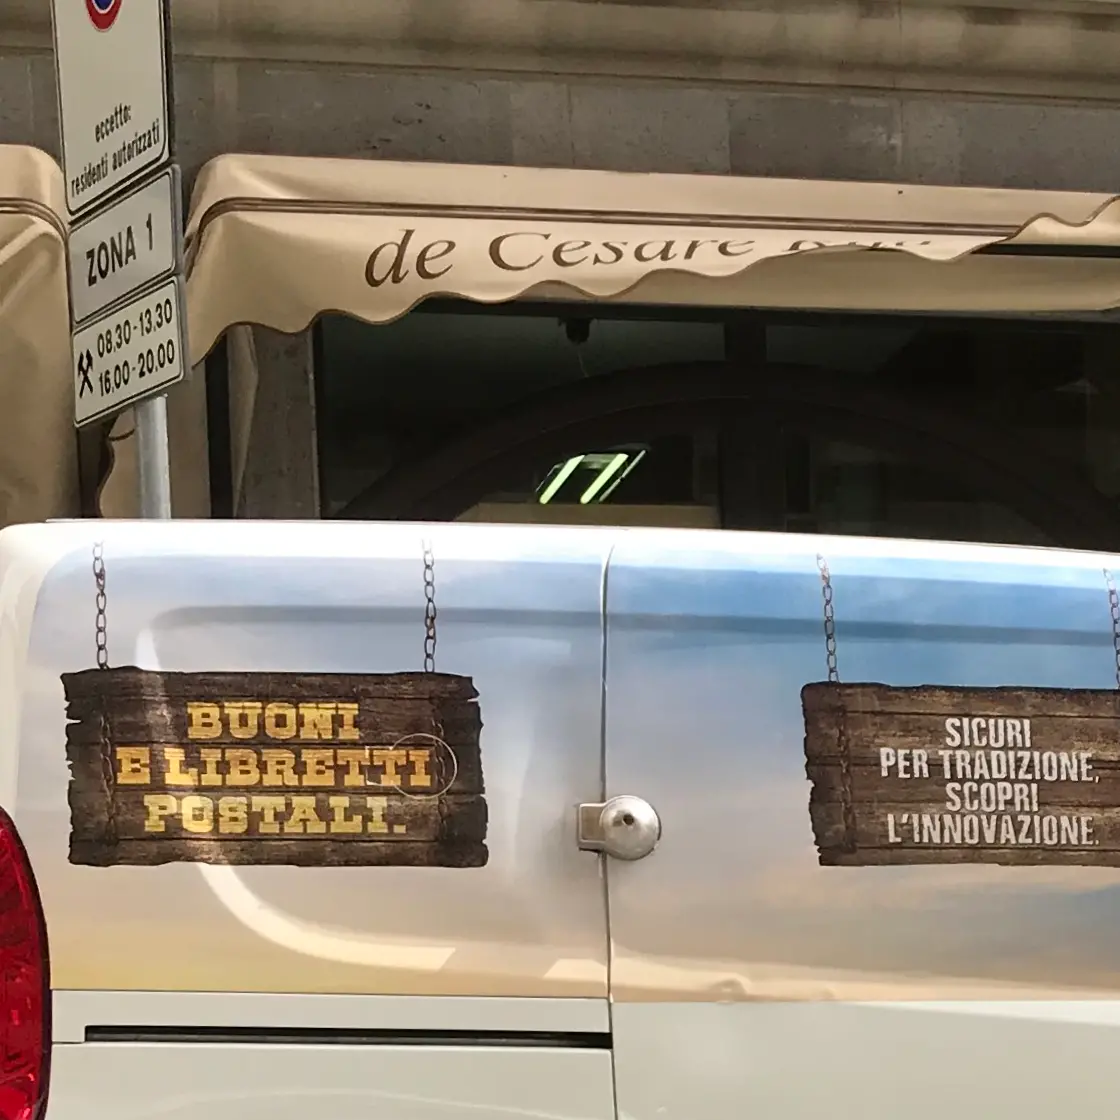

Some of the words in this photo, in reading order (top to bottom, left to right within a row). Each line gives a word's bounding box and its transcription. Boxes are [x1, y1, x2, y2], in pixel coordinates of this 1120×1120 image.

[95, 103, 131, 143] eccetto:
[71, 152, 108, 198] residenti
[112, 118, 160, 171] autorizzati
[86, 225, 136, 287] ZONA
[146, 213, 153, 251] 1
[365, 229, 456, 288] de
[489, 232, 755, 272] Cesare
[187, 701, 360, 740] BUONI
[945, 717, 1032, 749] SICURI
[115, 746, 151, 785] E
[163, 747, 432, 787] LIBRETTI
[879, 746, 930, 780] PER
[938, 749, 1100, 784] TRADIZIONE,
[144, 794, 407, 834] POSTALI.
[945, 781, 1039, 813] SCOPRI
[887, 813, 1100, 847] L'INNOVAZIONE.
